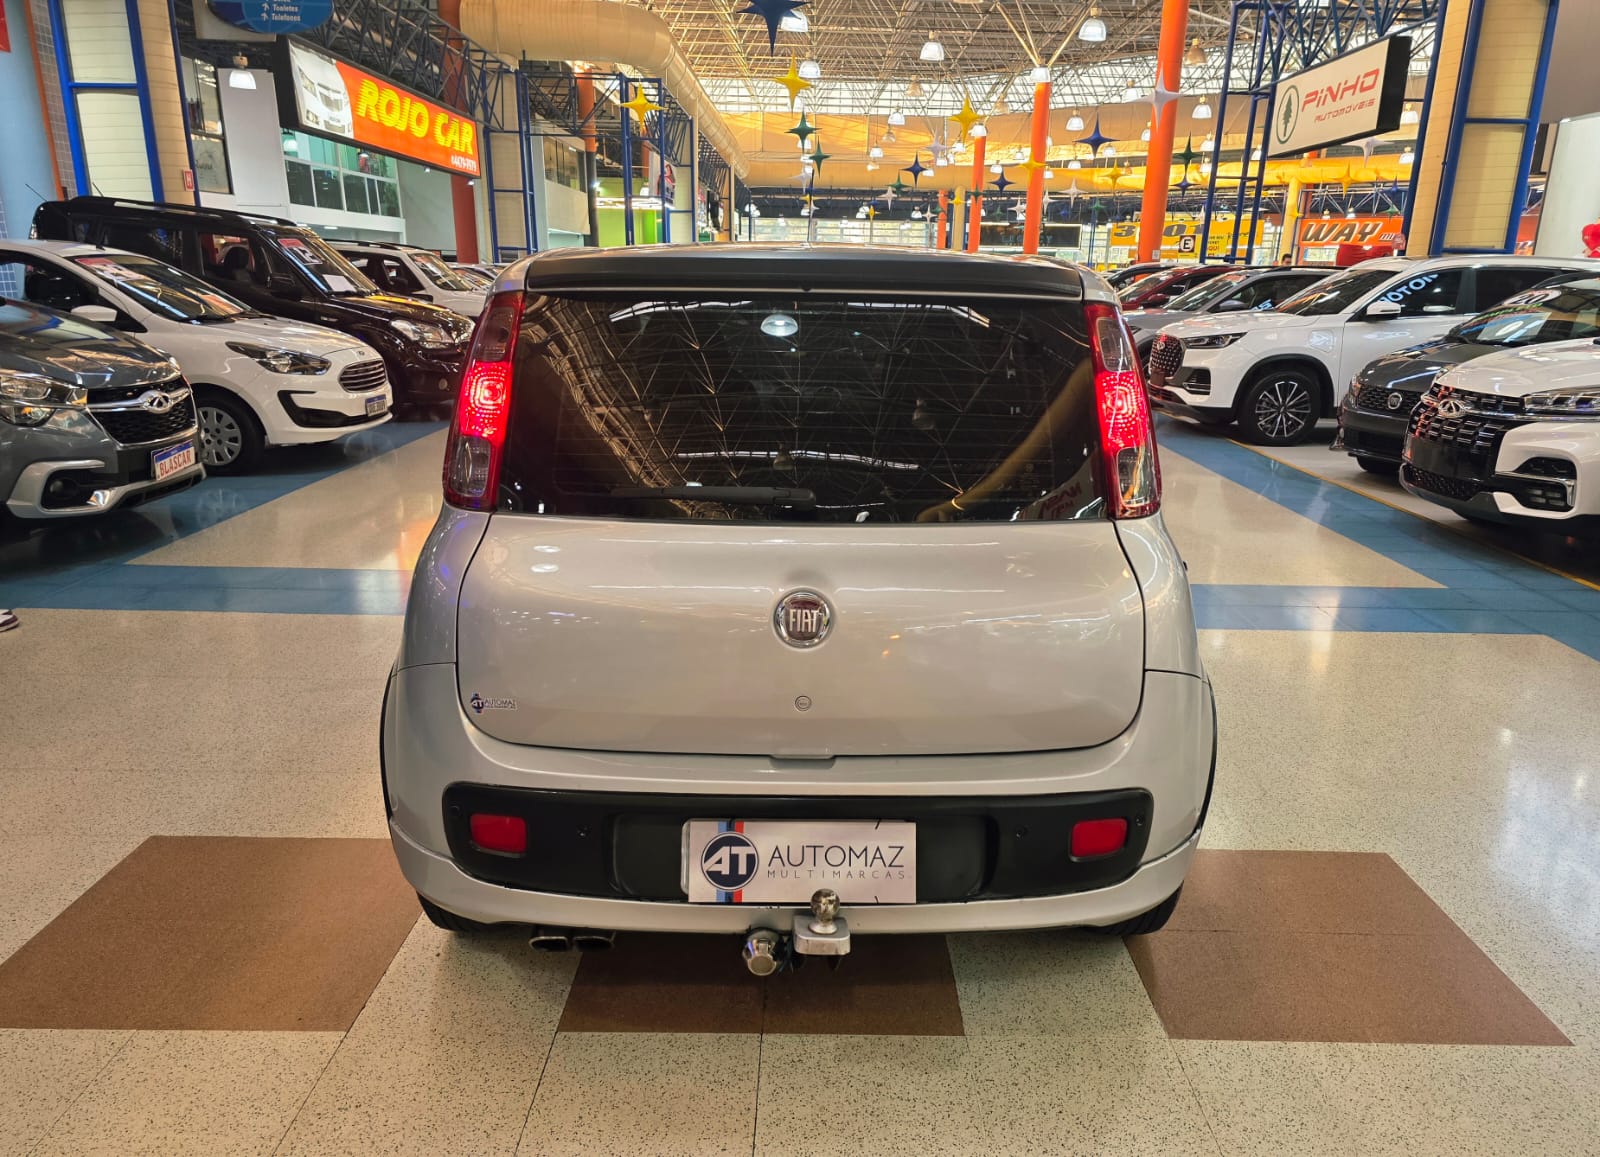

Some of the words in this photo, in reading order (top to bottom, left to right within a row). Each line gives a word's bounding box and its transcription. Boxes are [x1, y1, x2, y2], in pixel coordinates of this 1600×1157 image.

[356, 78, 430, 138] ROJO
[434, 112, 474, 155] CAR
[1301, 221, 1384, 243] WAY
[159, 450, 192, 477] BLASCAR
[789, 608, 819, 633] FIAT
[768, 845, 905, 868] AUTOMAZ
[767, 869, 905, 879] MULTIMARCAS
